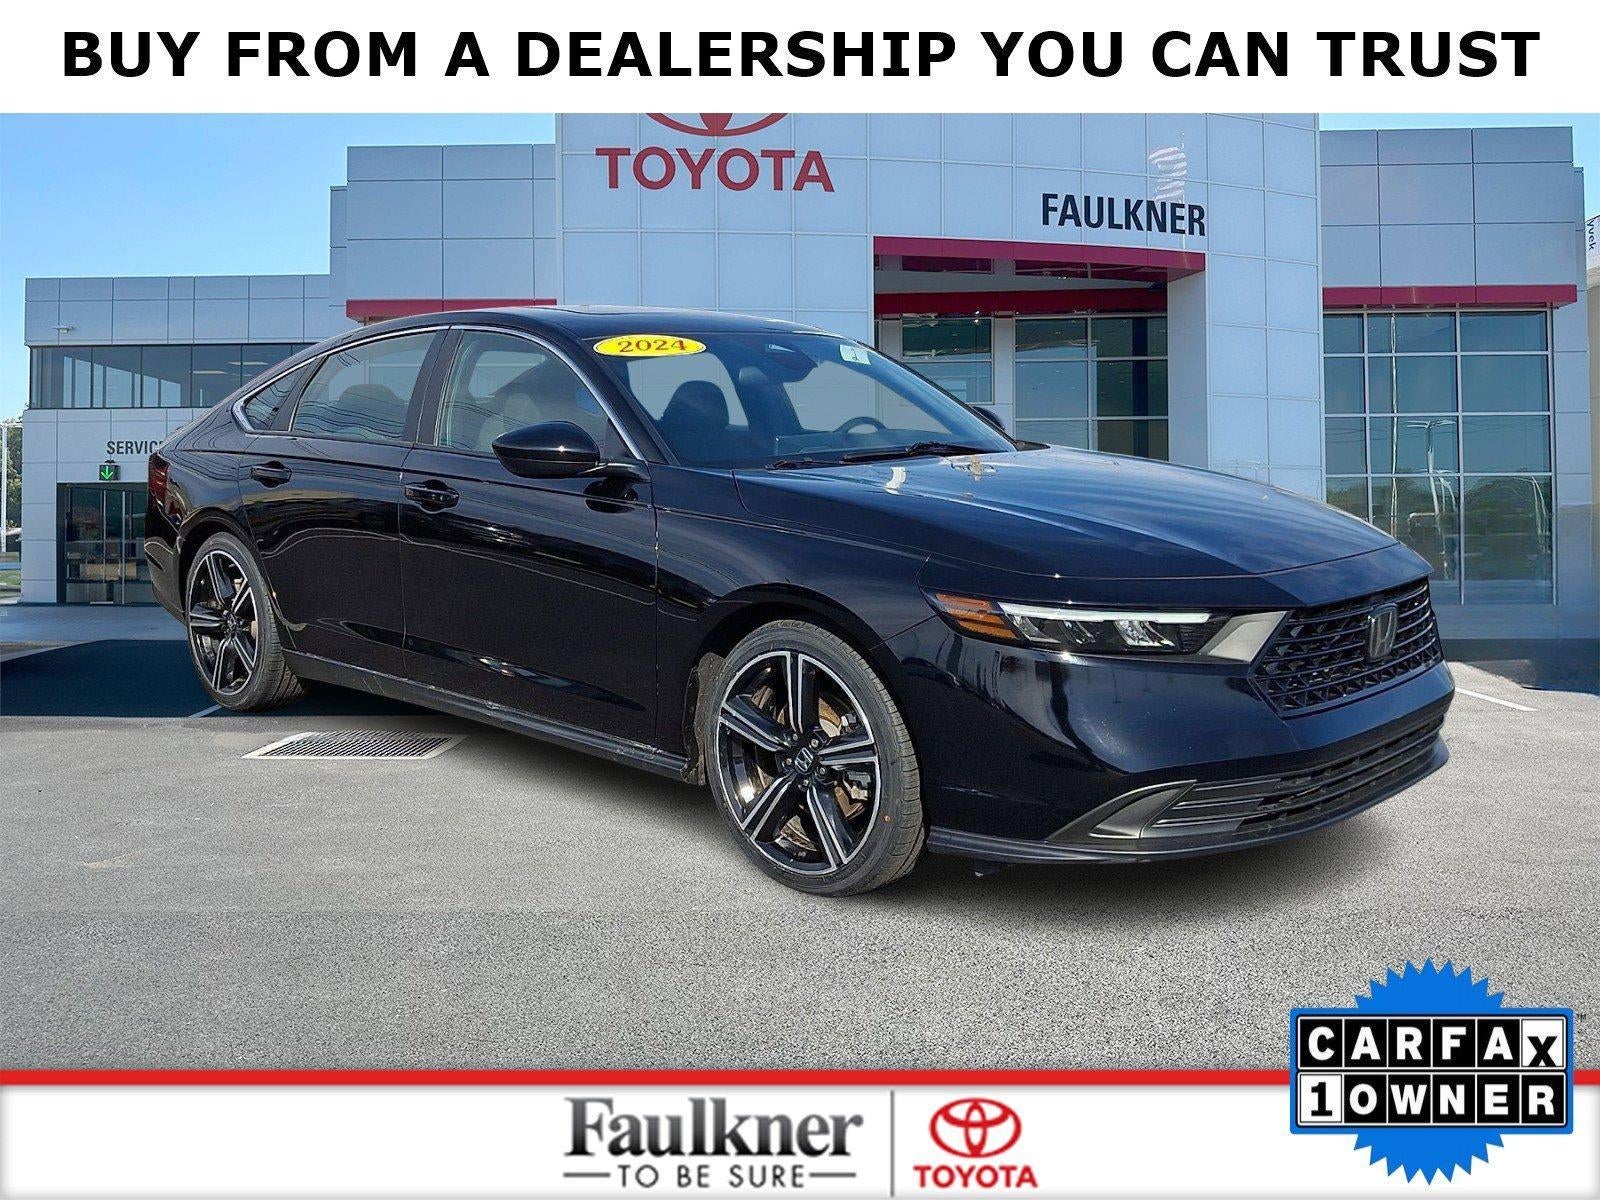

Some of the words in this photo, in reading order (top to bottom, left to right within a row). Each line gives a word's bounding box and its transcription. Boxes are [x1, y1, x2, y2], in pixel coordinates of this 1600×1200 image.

[596, 146, 835, 192] TOYOTA
[1042, 193, 1206, 236] FAULKNER
[617, 339, 687, 353] 2024
[106, 440, 164, 455] SERVIC
